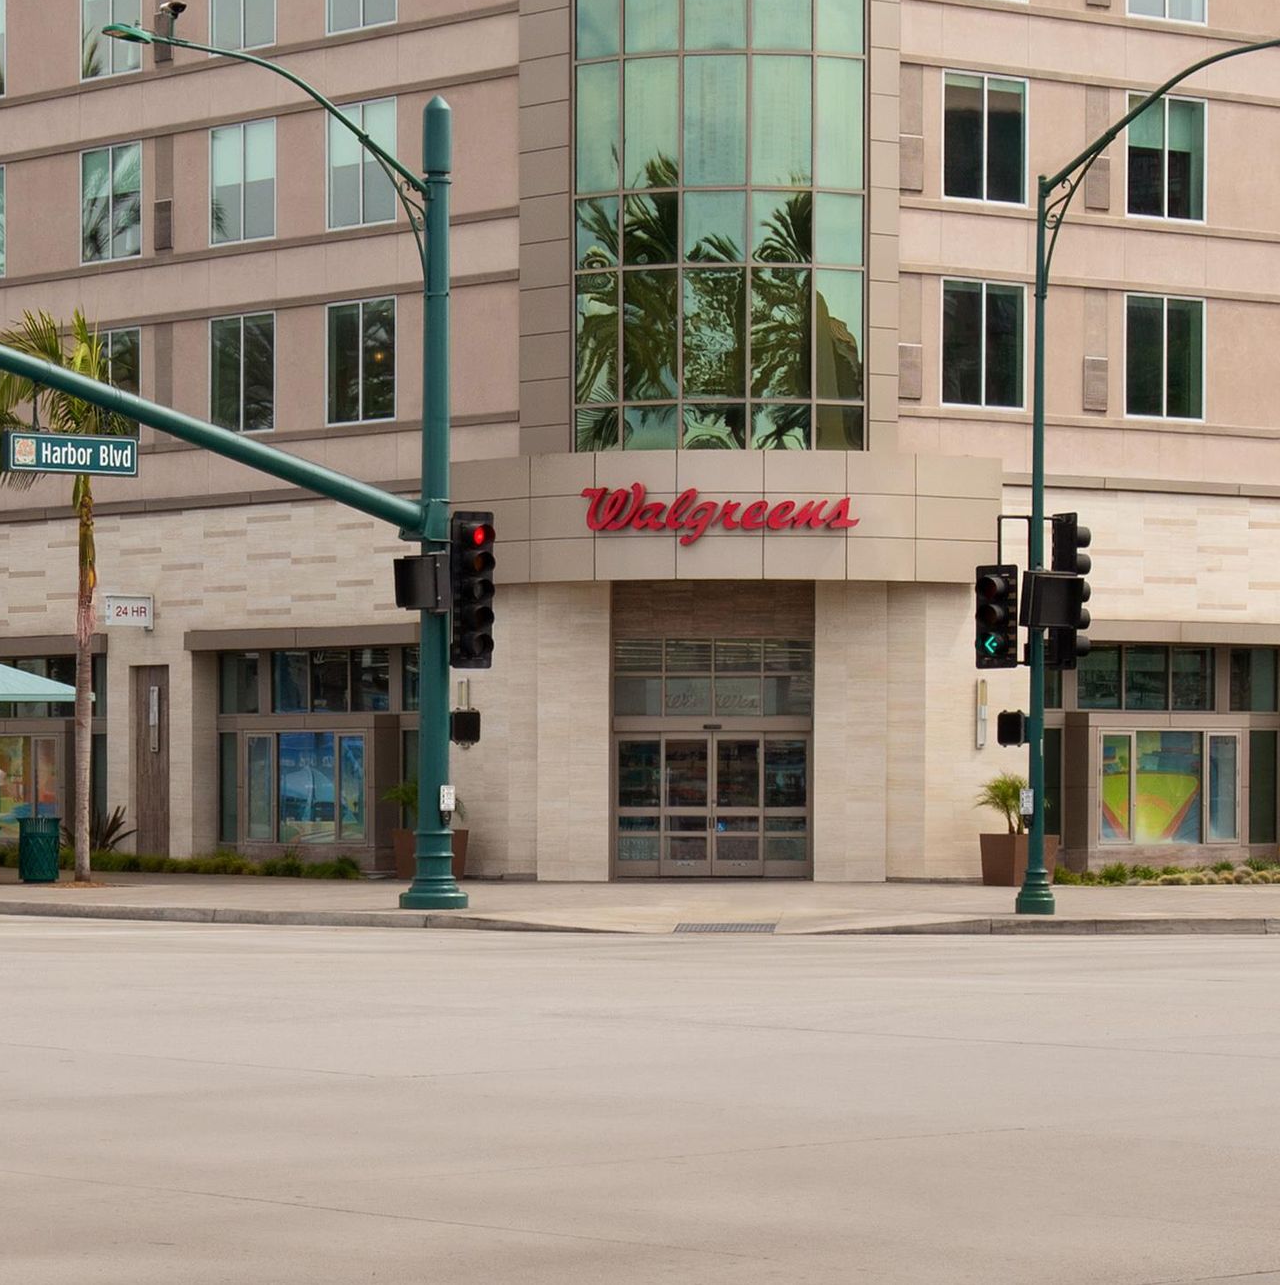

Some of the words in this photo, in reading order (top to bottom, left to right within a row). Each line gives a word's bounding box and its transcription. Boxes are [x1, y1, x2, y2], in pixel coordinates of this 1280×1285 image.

[41, 442, 93, 466] Harbor
[100, 444, 132, 468] Blvd
[581, 482, 860, 547] Walgreens
[115, 606, 128, 617] 24
[131, 606, 147, 618] HR
